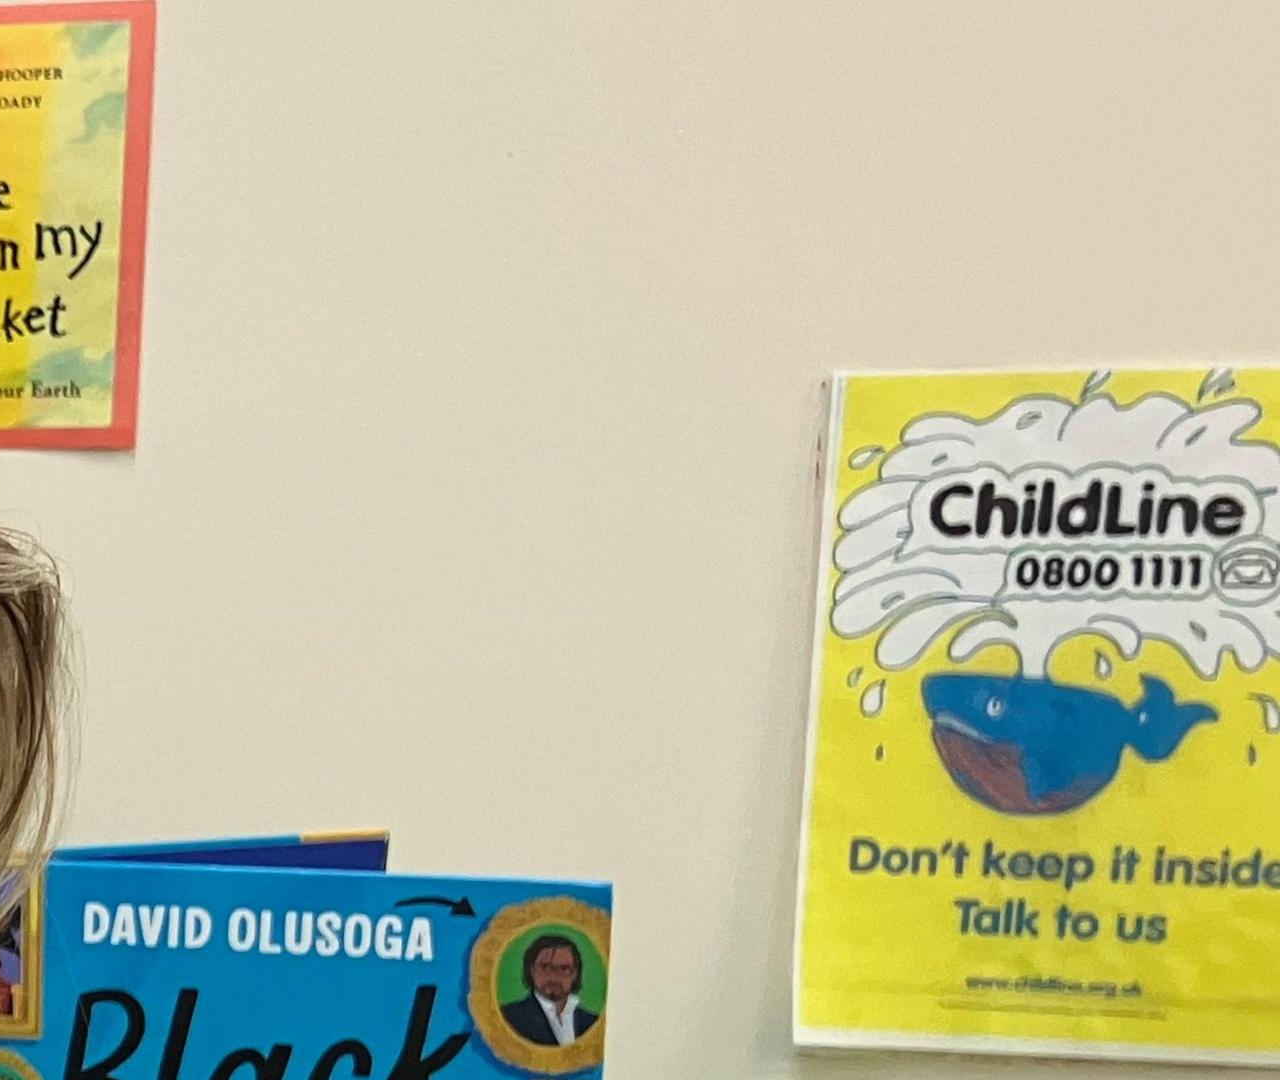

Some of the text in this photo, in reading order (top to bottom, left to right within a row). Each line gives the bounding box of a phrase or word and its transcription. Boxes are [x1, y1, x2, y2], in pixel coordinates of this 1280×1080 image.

[34, 220, 102, 280] my
[31, 380, 82, 398] Earth
[929, 478, 1246, 538] ChildLine
[1015, 556, 1203, 589] 0800 1111
[981, 840, 1095, 891] keep
[1110, 845, 1141, 884] it
[82, 901, 435, 962] DAVID OLUSOGA
[953, 898, 1168, 943] Talk to us
